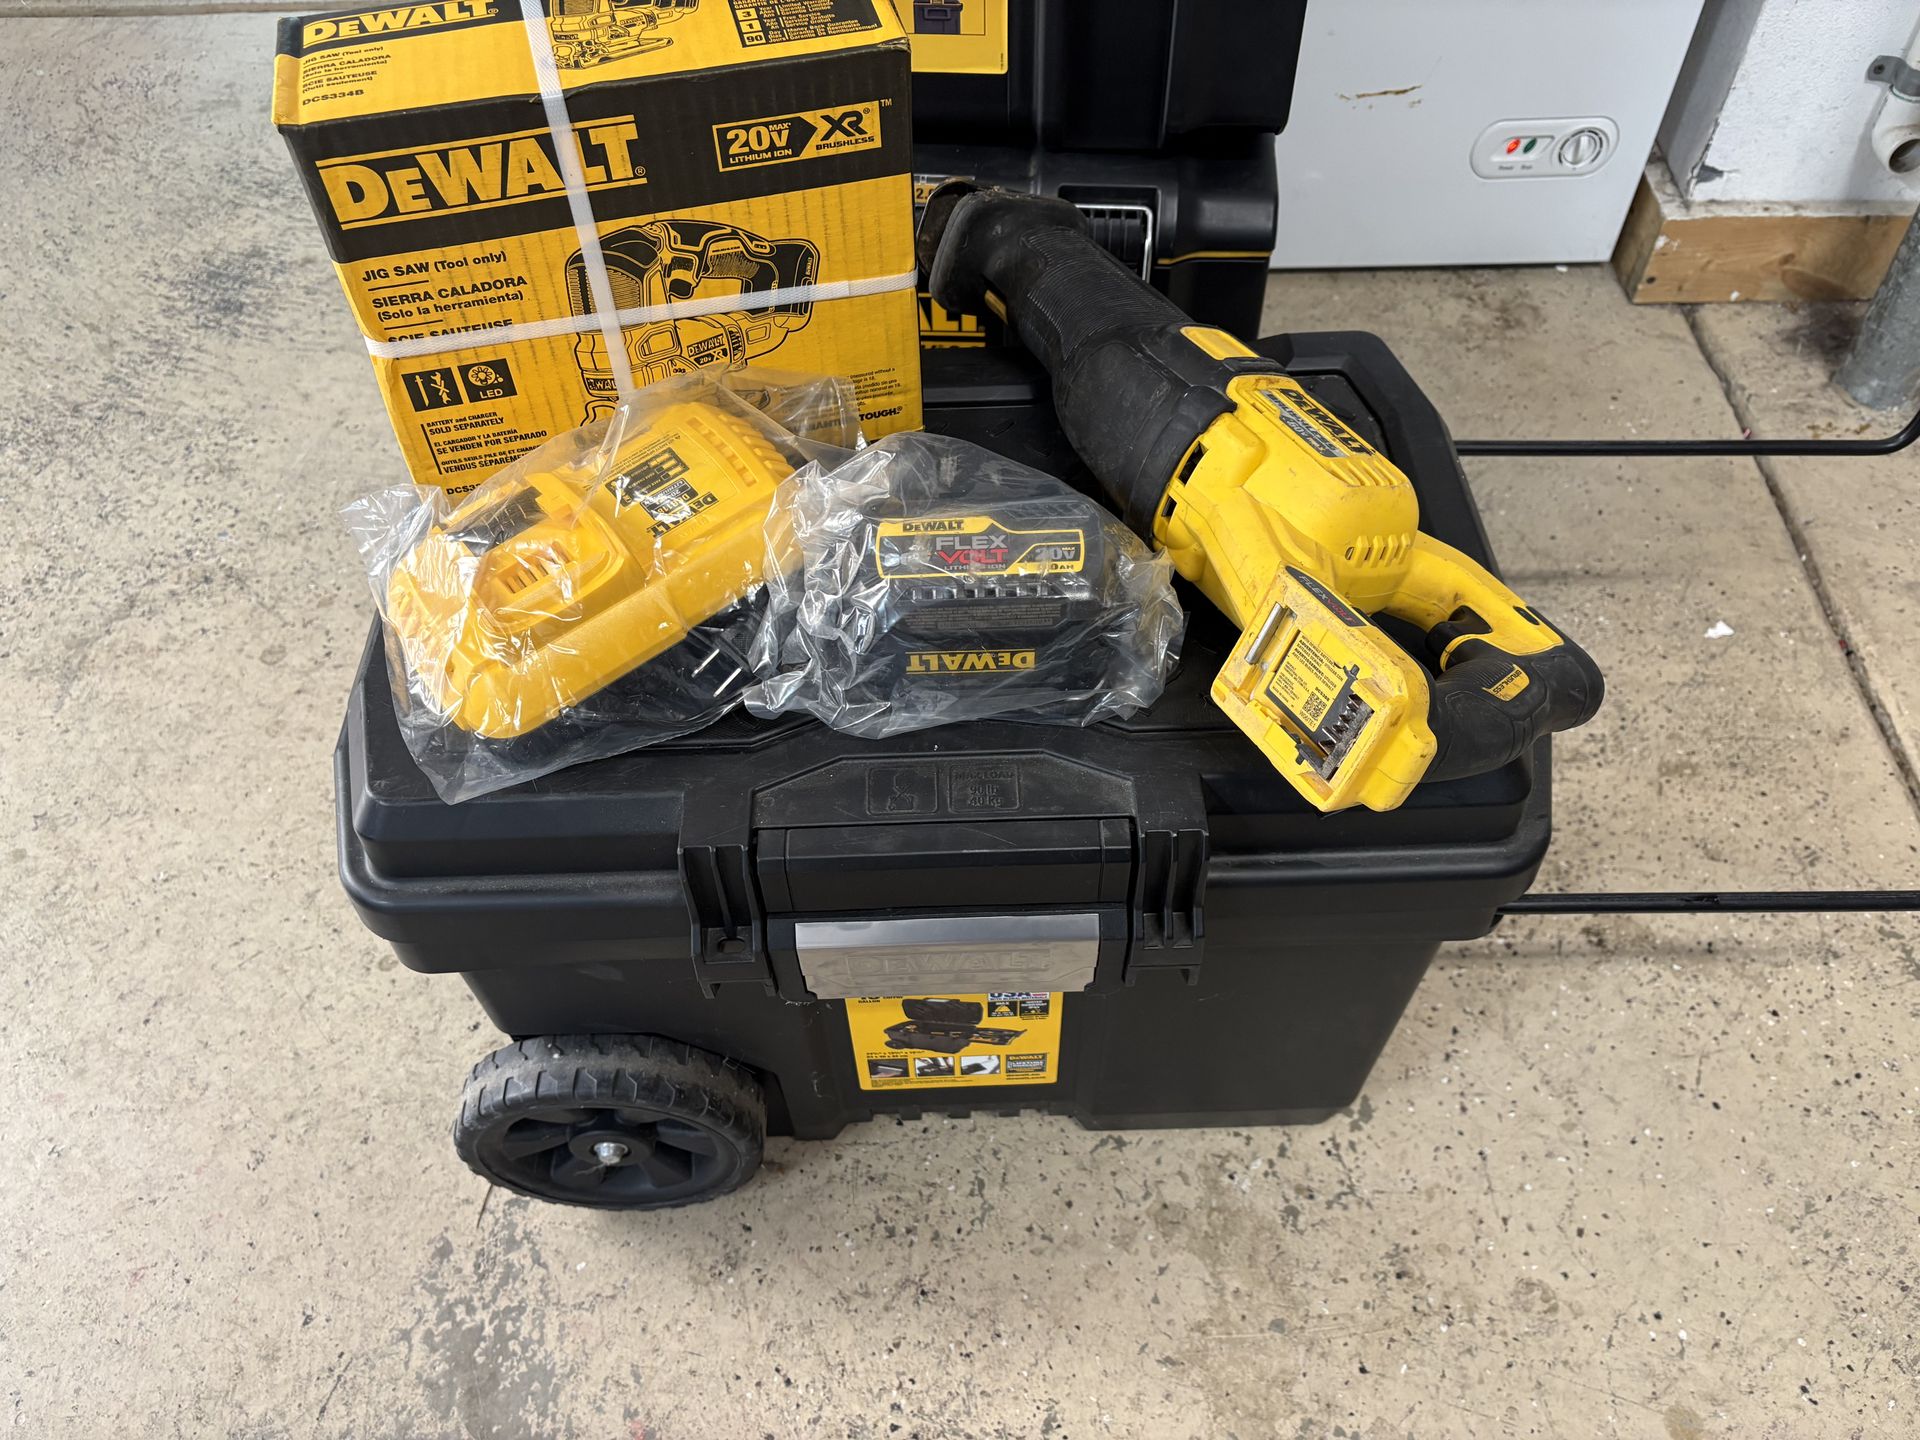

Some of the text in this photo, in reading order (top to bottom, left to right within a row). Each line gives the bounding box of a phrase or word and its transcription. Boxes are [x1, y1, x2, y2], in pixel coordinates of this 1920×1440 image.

[303, 0, 494, 46] DEWALT
[303, 55, 391, 74] SIERRA CALADORA
[320, 52, 340, 60] SAW
[326, 71, 378, 82] SAUTEUSE
[303, 89, 365, 106] DCS334B
[820, 110, 868, 142] XR
[726, 126, 790, 155] 20V
[815, 136, 875, 151] BRUSHLESS
[730, 149, 792, 164] LITHIUM ION
[319, 123, 639, 224] DEWALT
[362, 250, 507, 282] JIG SAW (Tool only)
[372, 275, 528, 309] SIERRA CALADORA
[377, 290, 524, 322] (Solo la herramienta)
[688, 335, 724, 356] DEWALT
[479, 388, 503, 399] LED
[426, 418, 453, 428] BATTERY
[467, 412, 497, 421] CHARGER
[429, 417, 505, 436] SOLD SEPARATELY
[1280, 388, 1372, 456] DEWALT
[436, 430, 548, 455] SE VENDEN POR SEPARADO
[442, 435, 477, 447] CARGADOR
[443, 463, 477, 475] VENDUS
[903, 520, 964, 532] DEWALT
[936, 535, 1008, 551] FLEX
[938, 549, 1008, 564] VOLT
[908, 651, 1035, 672] DEWALT
[1492, 669, 1522, 695] BRUSHLESS
[852, 951, 1050, 975] DEWALT
